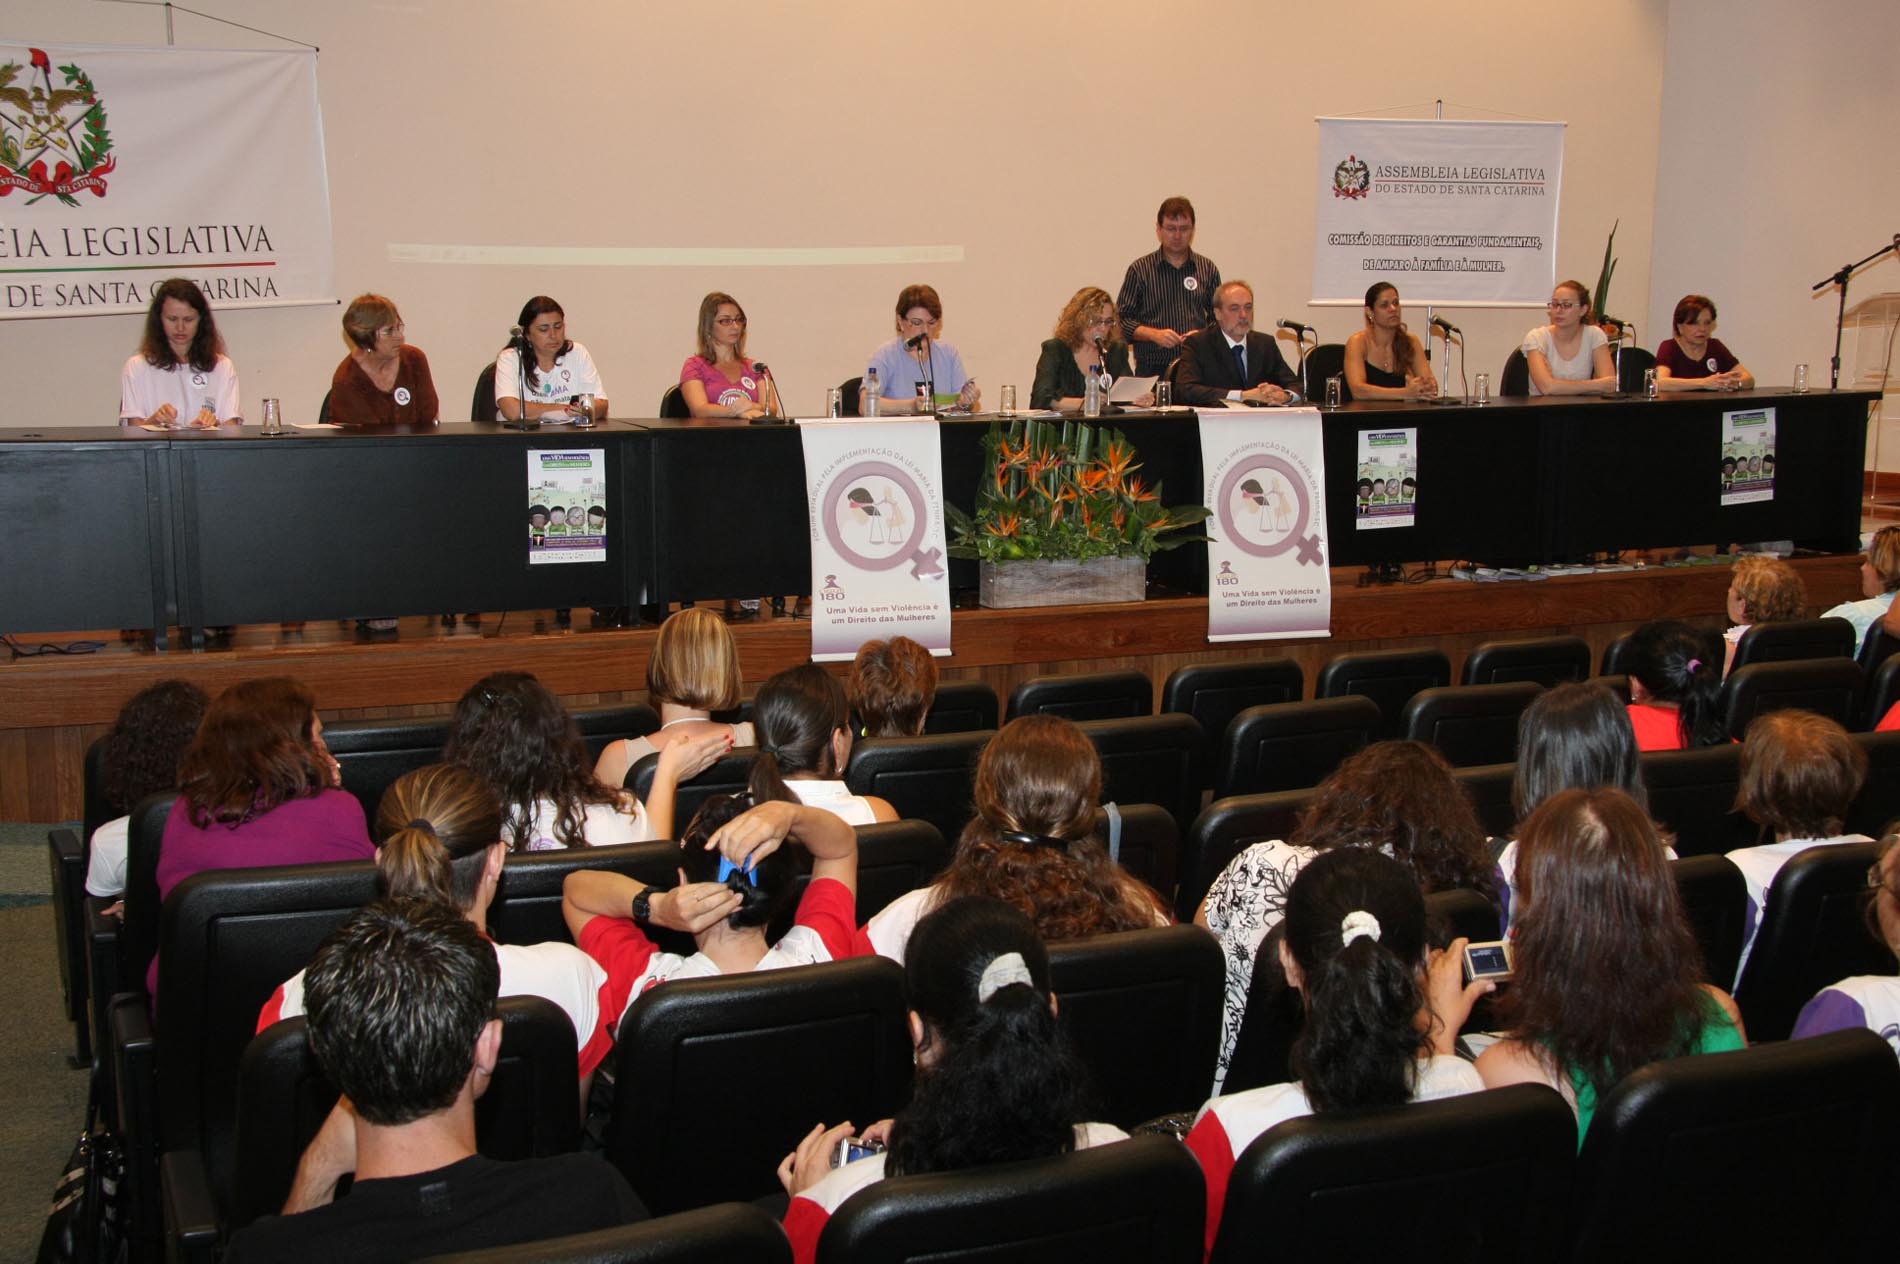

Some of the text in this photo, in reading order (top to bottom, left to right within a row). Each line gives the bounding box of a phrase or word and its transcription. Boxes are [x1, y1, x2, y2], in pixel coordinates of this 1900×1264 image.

[1375, 166, 1545, 181] ASSEMBLEIA LEGISLATIVA
[1375, 183, 1545, 196] DO ESTADO DE SANTA CATARINA
[62, 225, 275, 257] LEGISLATIVA
[1328, 231, 1543, 249] COMISSÃO DE DIREITOS E GARANTIAS FUNDAMENTAIS,
[1363, 258, 1375, 271] DE
[1375, 259, 1411, 271] AMPARO
[1420, 256, 1454, 272] FAMÍLIA
[1455, 259, 1461, 271] E
[1469, 260, 1506, 273] MULHER.
[7, 277, 279, 308] DE SANTA CARINA
[834, 447, 893, 466] IMPLEMENTAÇÃO
[894, 452, 904, 463] DA
[1216, 577, 1239, 586] 180
[820, 592, 845, 601] 180
[1222, 591, 1240, 599] Uma
[1279, 587, 1314, 596] Violência
[826, 607, 846, 615] Uma
[849, 605, 868, 613] Vida
[891, 604, 931, 612] Violência
[1240, 599, 1266, 607] Direito
[847, 616, 877, 624] Direito
[879, 615, 895, 623] das
[897, 614, 936, 622] Mulheres
